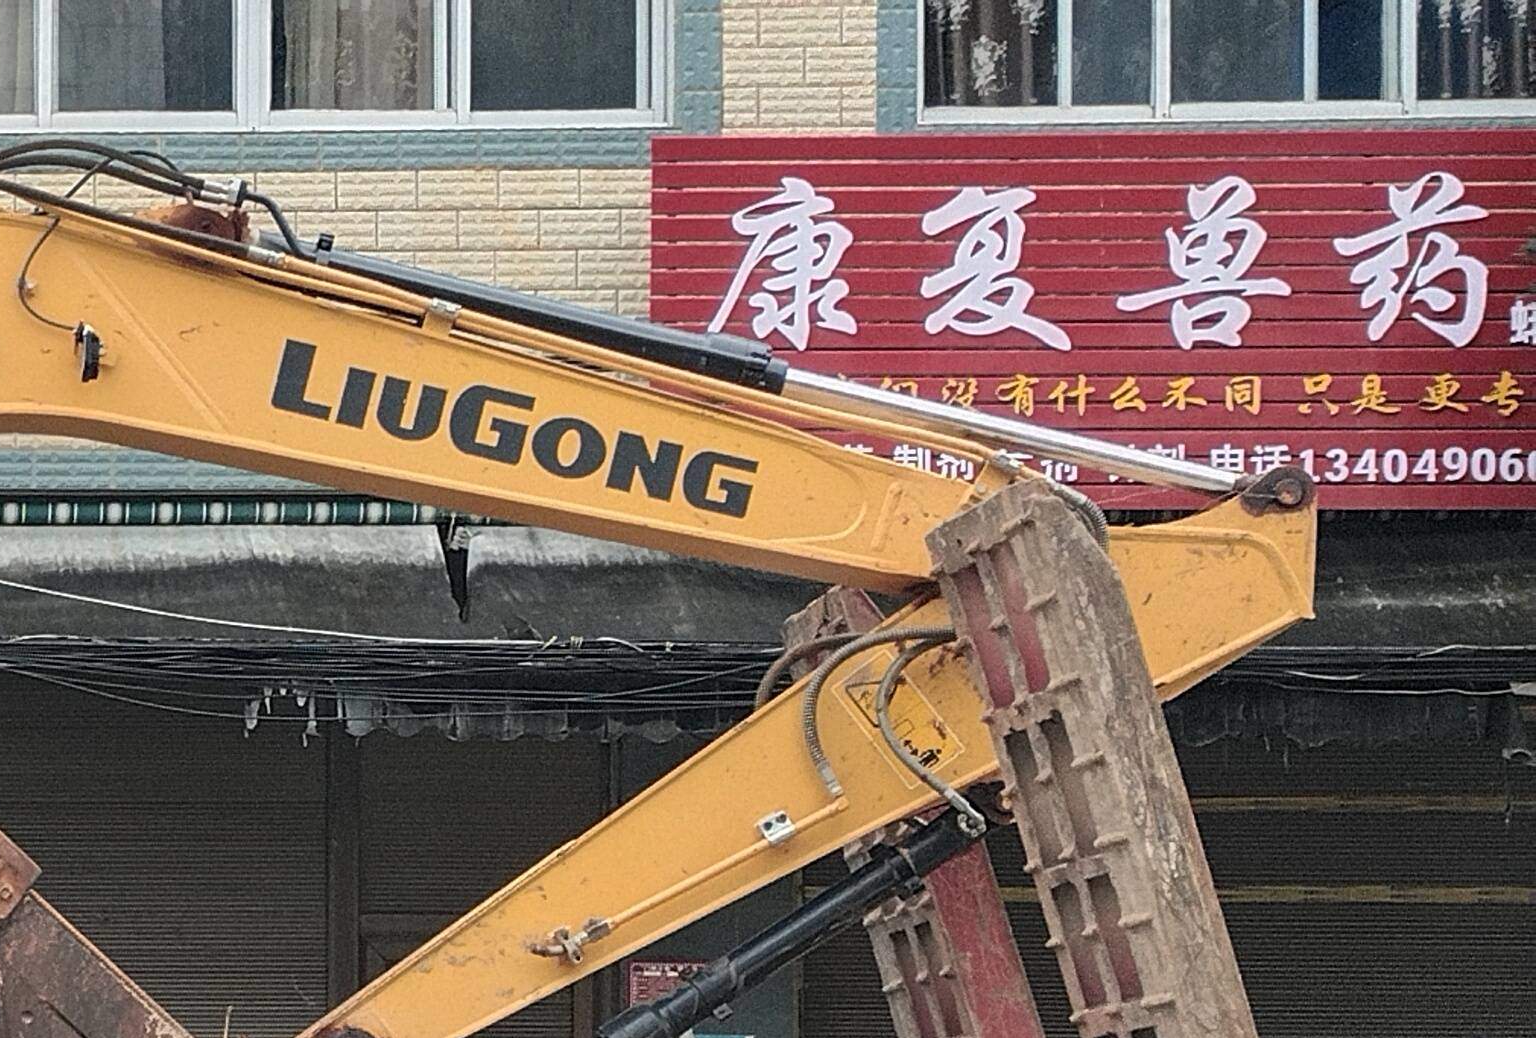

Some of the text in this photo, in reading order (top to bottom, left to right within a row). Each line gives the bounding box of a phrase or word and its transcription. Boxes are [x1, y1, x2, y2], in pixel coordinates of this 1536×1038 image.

[707, 171, 1489, 351] 康复兽药
[837, 373, 1262, 417] 没有什么不同
